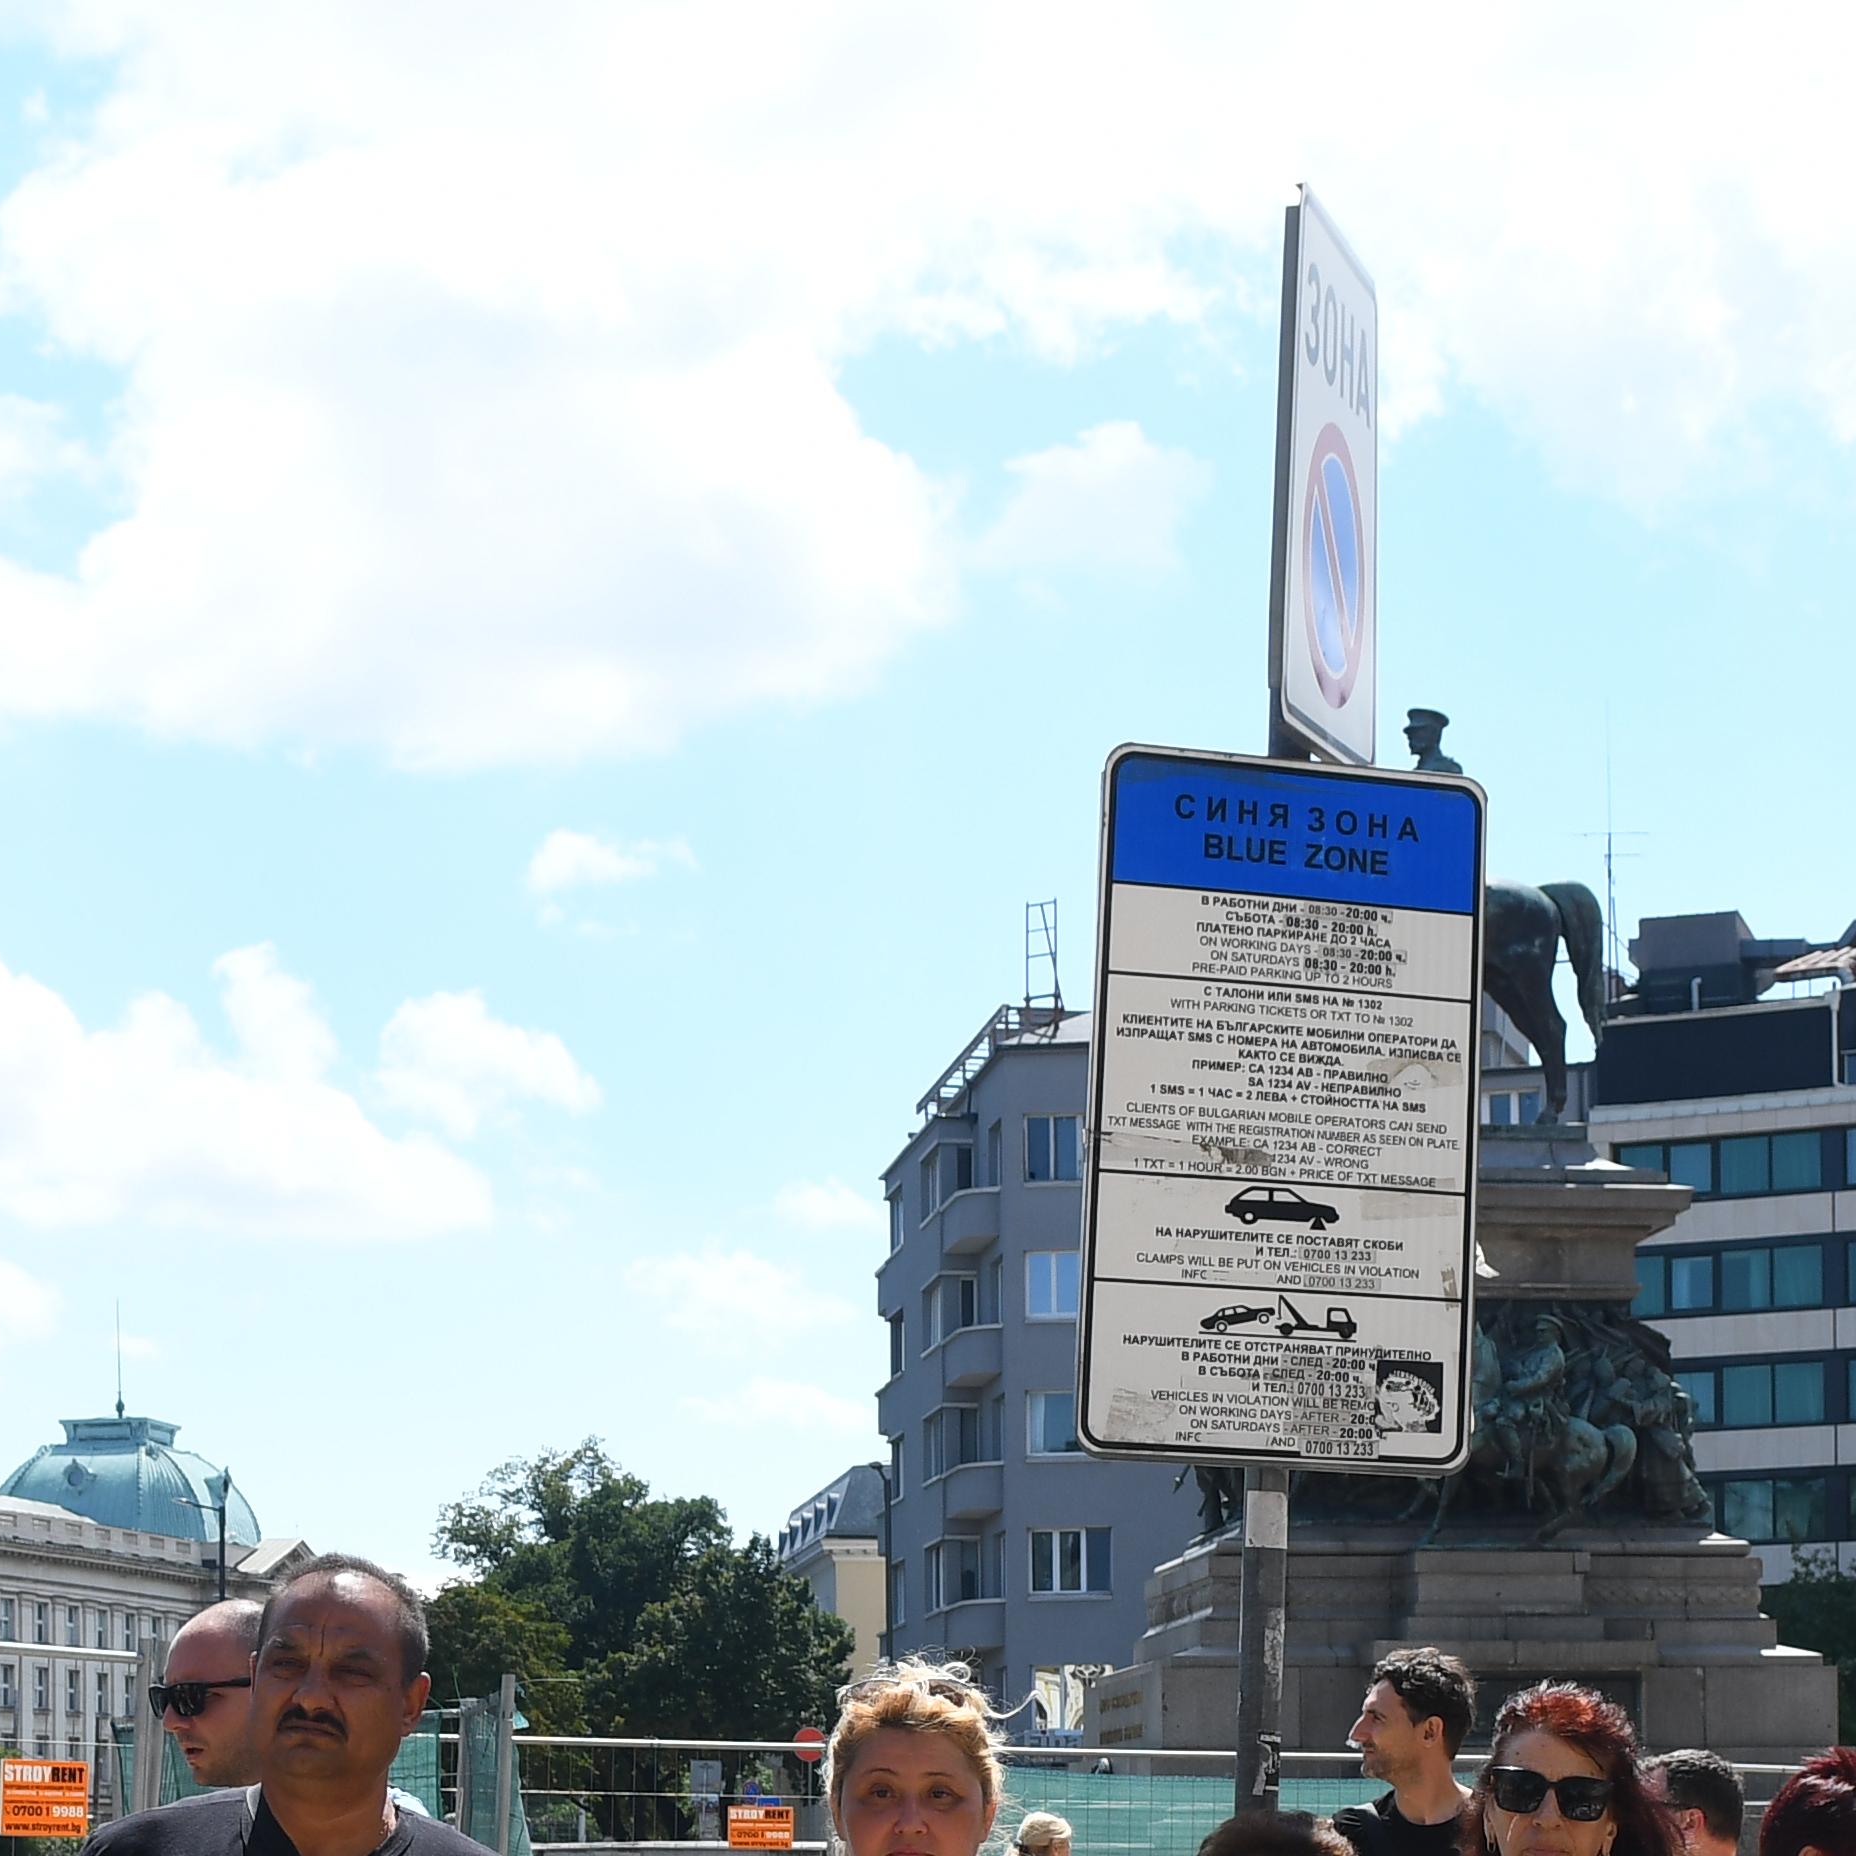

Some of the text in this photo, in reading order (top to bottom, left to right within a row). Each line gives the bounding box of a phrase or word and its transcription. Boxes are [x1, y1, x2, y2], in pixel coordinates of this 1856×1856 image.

[1305, 262, 1371, 429] ЗОНА
[1175, 794, 1419, 842] СИНЯ ЗОНА
[1204, 833, 1388, 875] BLUE ZONE
[1197, 922, 1391, 948] ПЛАТЕНО ПАРКИРАНЕ ДО 2 ЧАСА
[1204, 986, 1212, 996] С
[1216, 987, 1264, 999] ТАЛОНИ
[1268, 991, 1291, 1002] ИЛИ
[1296, 993, 1319, 1004] SMS
[1323, 996, 1338, 1007] НА
[1358, 1000, 1382, 1010] 1302
[1171, 999, 1200, 1010] WITH
[1204, 1001, 1255, 1015] PARKING
[1259, 1004, 1307, 1019] TICKETS
[1310, 1009, 1326, 1020] OR
[1331, 1011, 1351, 1022] TXT
[1355, 1012, 1370, 1023] TO
[1390, 1016, 1413, 1027] 1302
[1116, 1027, 1184, 1041] ИЗПРАЩАТ
[1188, 1031, 1212, 1043] SMS
[1216, 1034, 1224, 1044] С
[1228, 1034, 1277, 1048] НОМЕРА
[1281, 1038, 1298, 1050] НА
[1389, 1048, 1443, 1062] ИЗПИСВА
[1447, 1052, 1461, 1063] СЕ
[1123, 1014, 1456, 1050] КЛИЕНТИТЕ НА БЪЛГАРСКИТЕ МОБИЛНИ ОПЕРАТОРИ ДА
[1126, 1102, 1447, 1135] CLIENTS OF BULGARIAN MOBILE OPERATORS CAN SEND
[1156, 1227, 1403, 1251] НА НАРУШИТЕЛИТЕ СЕ ПОСТАВЯТ СКОБИ
[1137, 1252, 1419, 1279] CLAMPS WILL BE PUT ON VEHICLES IN VIOLATION
[1123, 1335, 1431, 1360] НАРУШИТЕЛИТЕ СЕ ОТСТРАНЯВАТ ПРИНУДИТЕЛНО
[5, 1764, 84, 1783] STROYRENT
[5, 1822, 80, 1833] www.stroyrent.bg
